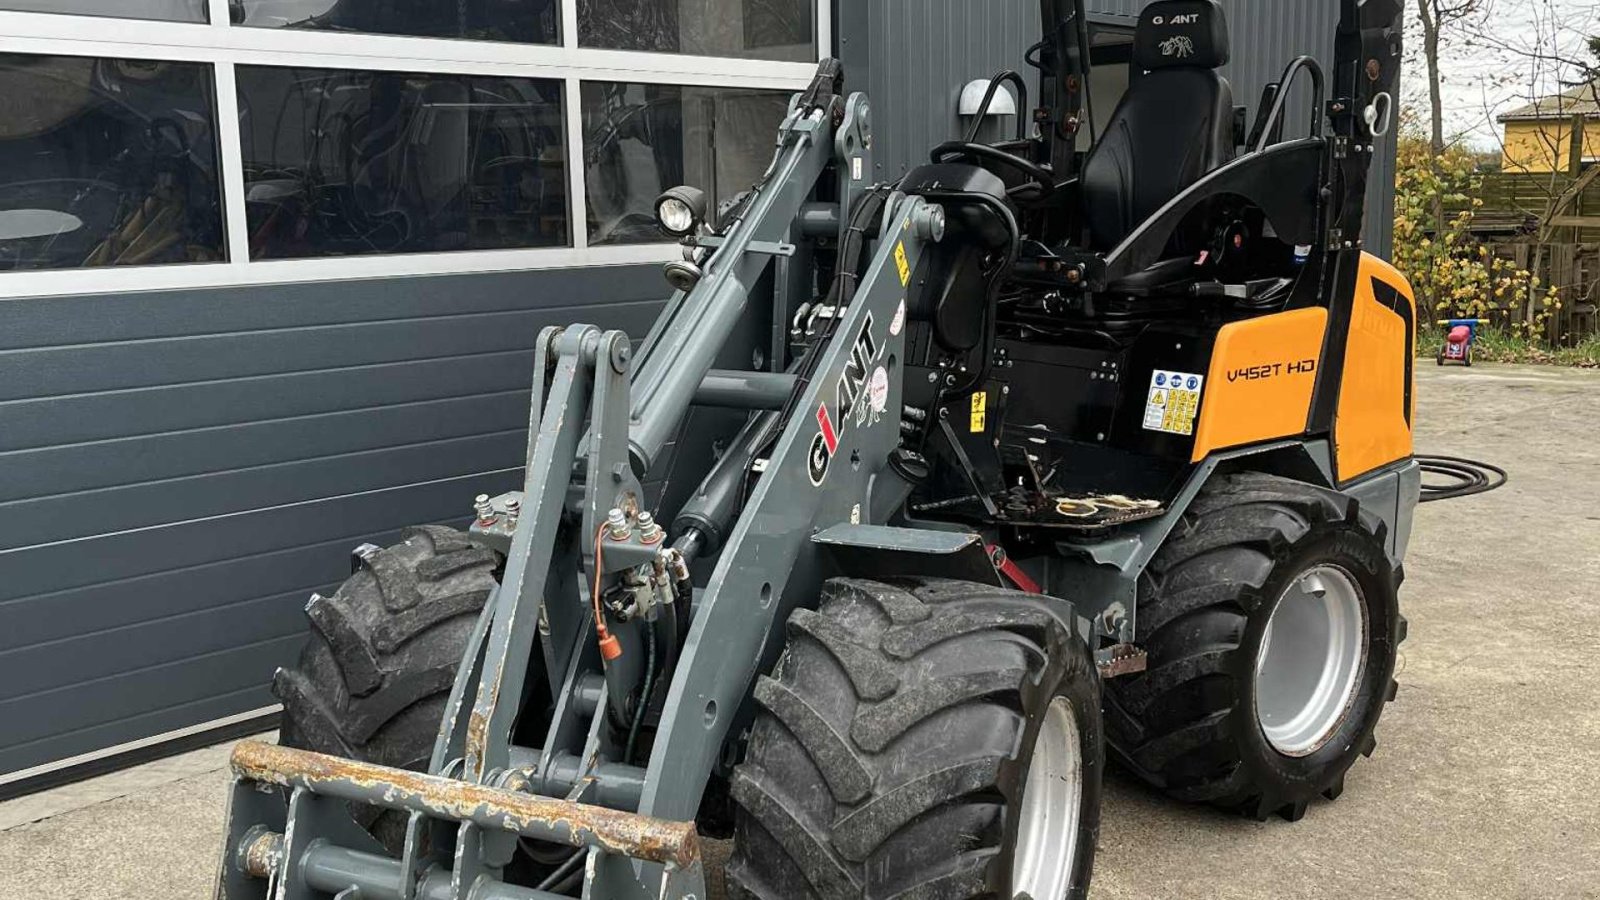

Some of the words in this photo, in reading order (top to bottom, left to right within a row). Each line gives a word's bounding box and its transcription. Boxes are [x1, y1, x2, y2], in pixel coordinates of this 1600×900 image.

[1152, 13, 1199, 25] GANT
[1227, 363, 1282, 382] V452T
[1287, 359, 1315, 374] HD
[807, 309, 877, 487] GIANT
